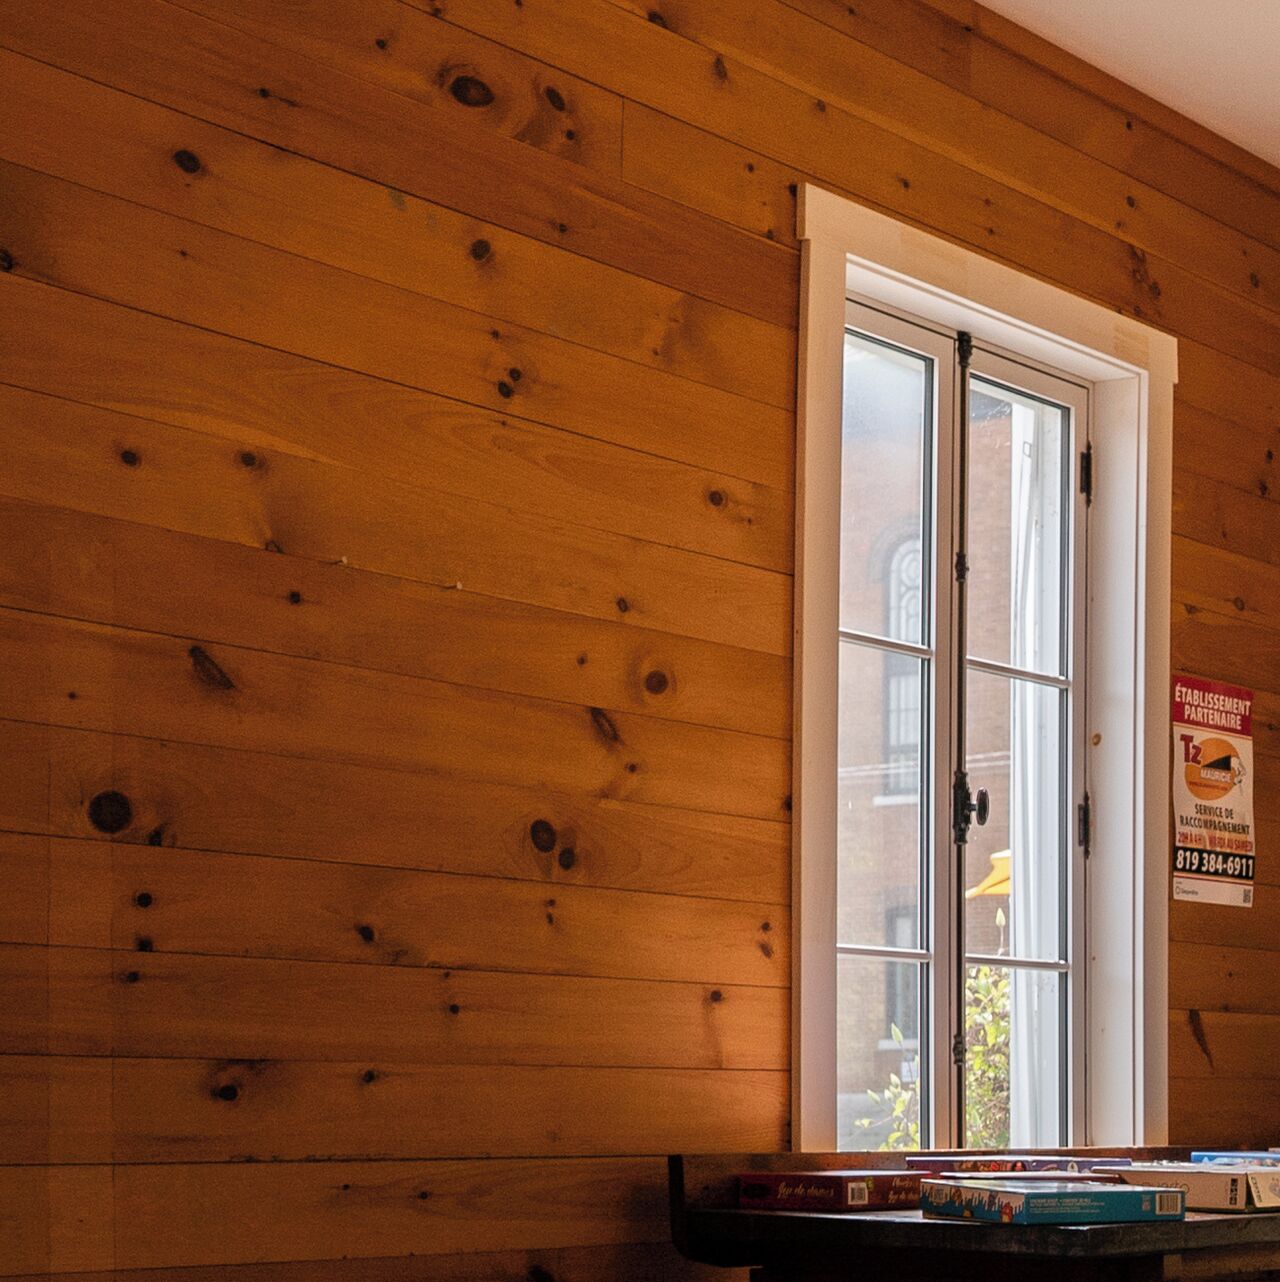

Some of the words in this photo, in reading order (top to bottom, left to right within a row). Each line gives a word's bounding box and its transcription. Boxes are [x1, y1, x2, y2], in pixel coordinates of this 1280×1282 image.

[1175, 682, 1251, 716] ÉTABLISSEMENT
[1184, 705, 1242, 730] PARTENAIRE
[1195, 803, 1223, 818] SERVICE
[1225, 808, 1234, 819] DE
[1180, 815, 1250, 835] RACCOMPAGNEMENT
[1176, 849, 1199, 871] 819
[1201, 852, 1253, 878] 384-6911
